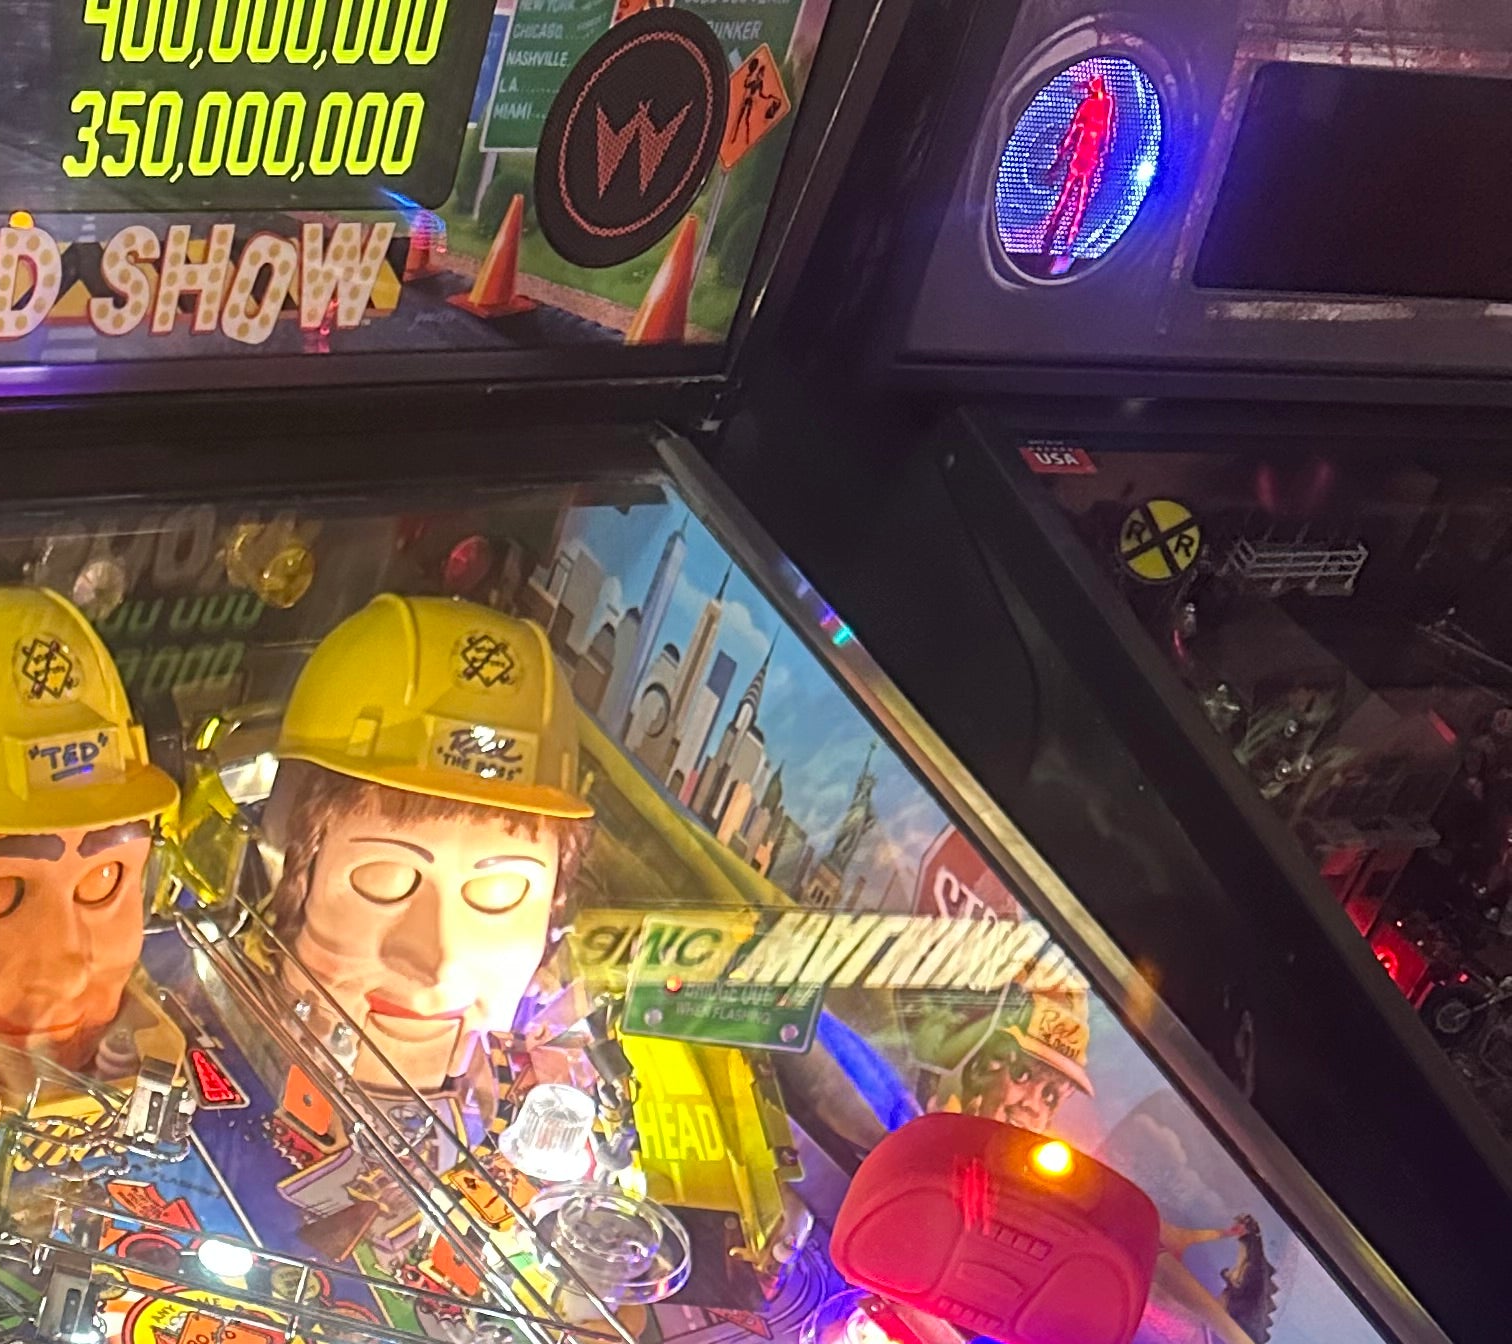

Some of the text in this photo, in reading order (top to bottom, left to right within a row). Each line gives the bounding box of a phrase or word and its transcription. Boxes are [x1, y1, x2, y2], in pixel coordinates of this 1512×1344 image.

[84, 0, 447, 70] 400,000,000
[505, 50, 569, 68] NASHVILLE
[62, 90, 425, 183] 350,000,000
[89, 222, 396, 345] SHOW
[1035, 452, 1079, 466] USA
[633, 1101, 726, 1161] HEAD
